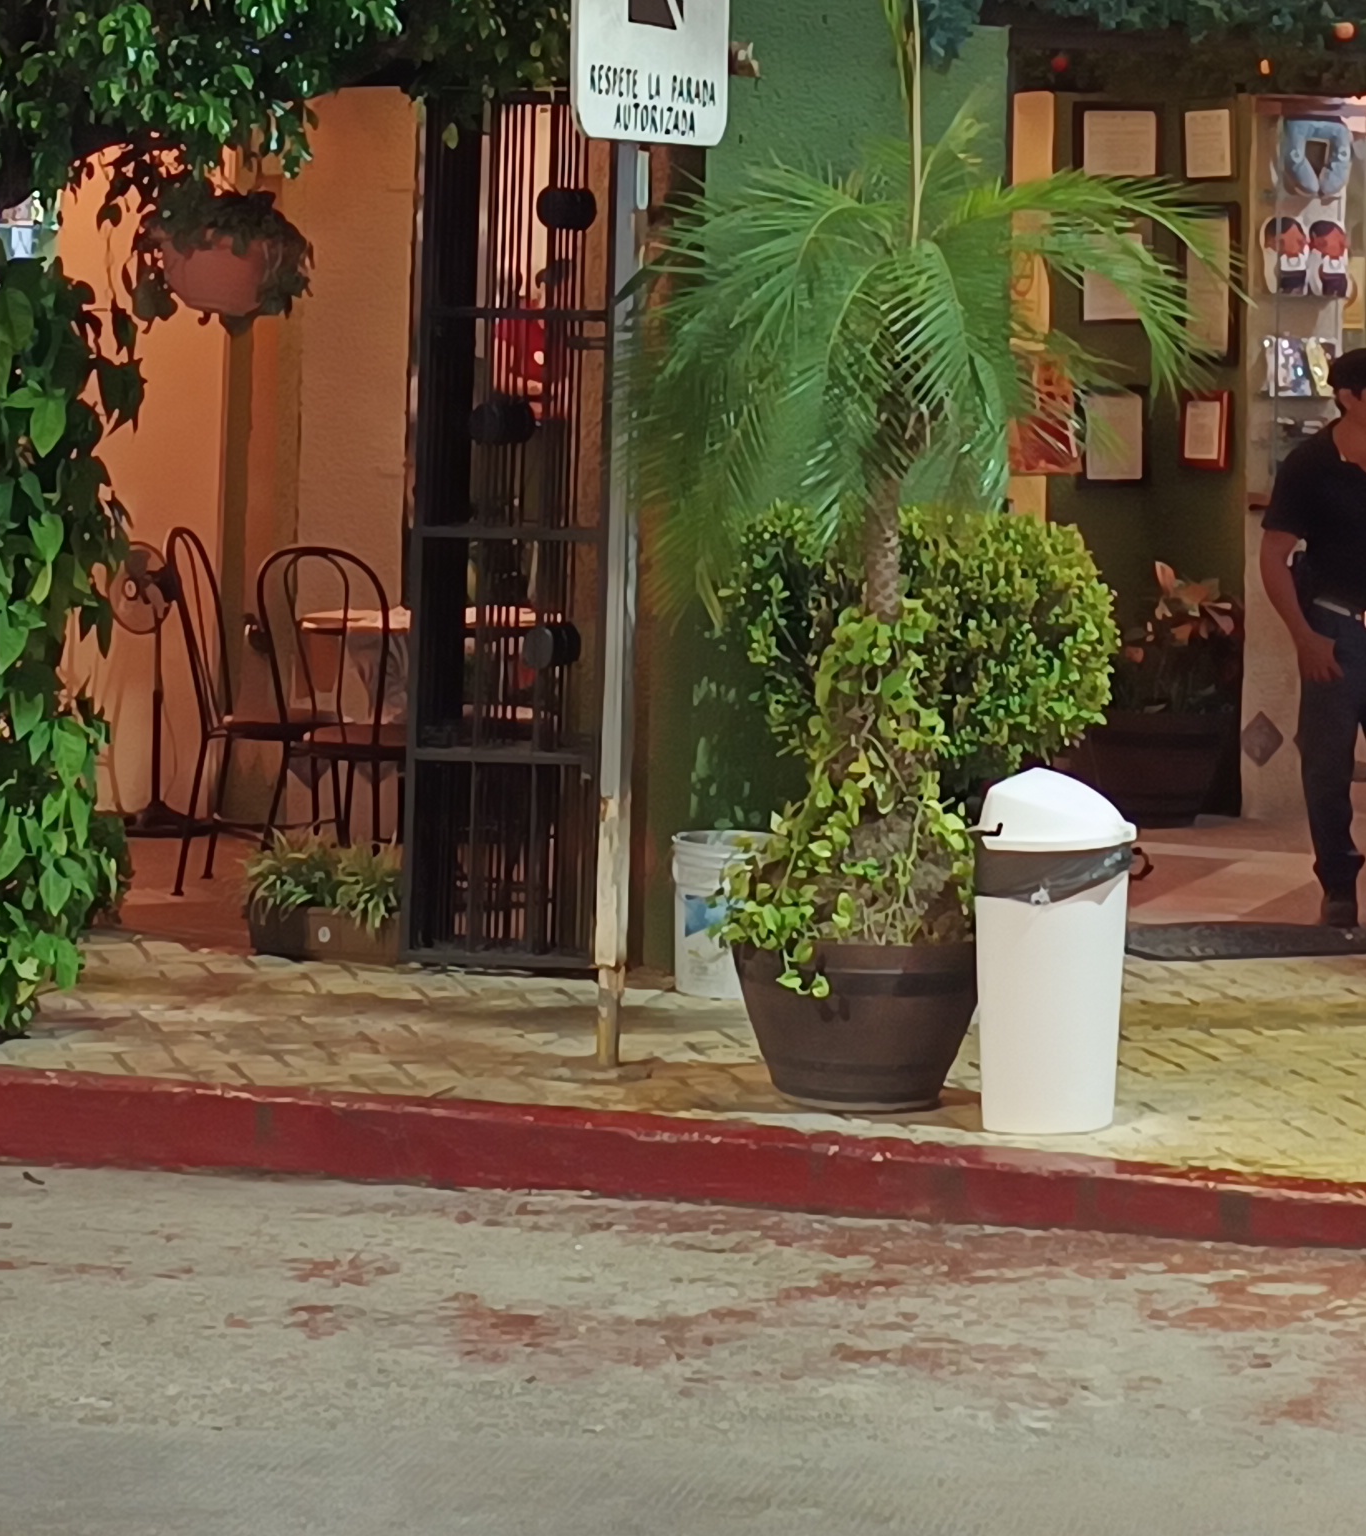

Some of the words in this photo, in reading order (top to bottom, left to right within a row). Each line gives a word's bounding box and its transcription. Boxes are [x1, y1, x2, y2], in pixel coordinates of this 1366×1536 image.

[589, 63, 638, 100] RESPETE
[647, 72, 661, 101] LA
[671, 74, 717, 108] PARADA
[613, 102, 697, 138] AUTORIZADA
